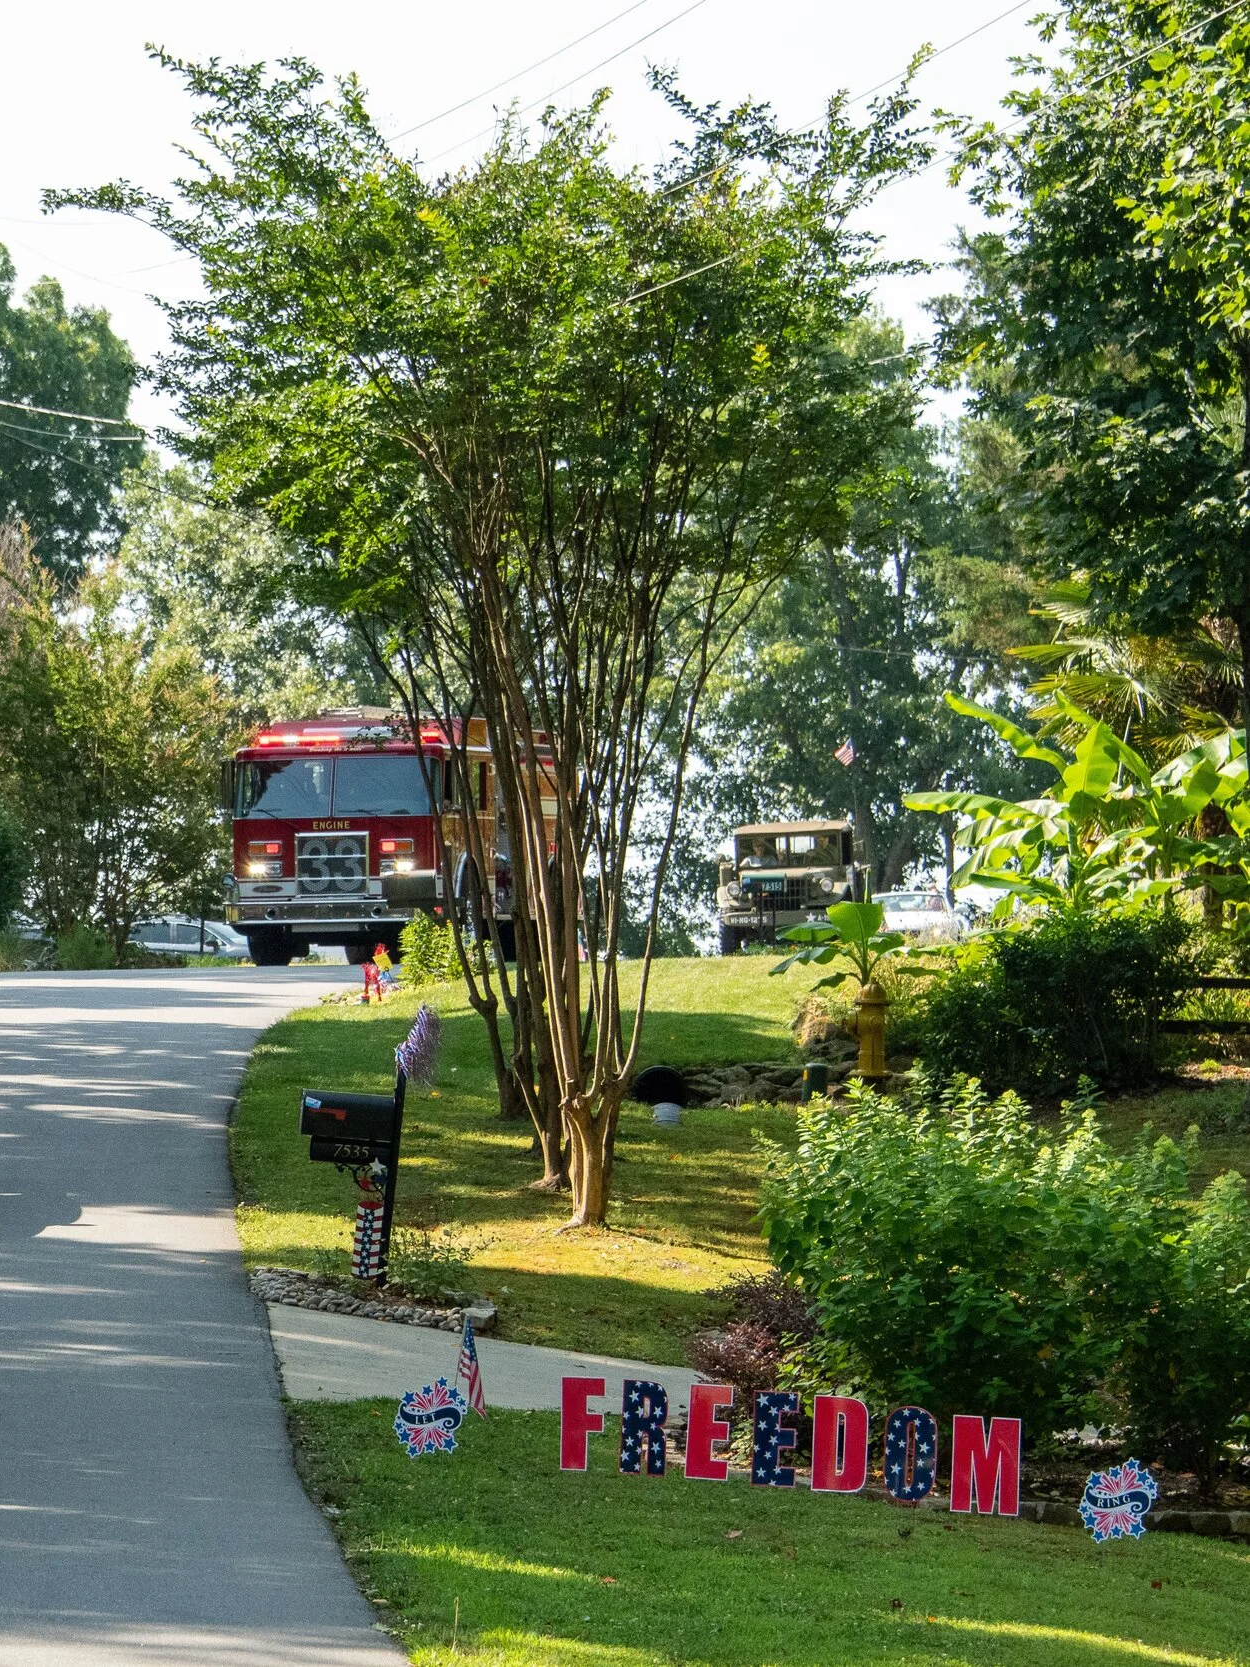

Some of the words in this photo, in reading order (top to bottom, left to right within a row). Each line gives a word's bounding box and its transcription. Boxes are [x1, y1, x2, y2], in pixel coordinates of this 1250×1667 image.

[312, 820, 351, 830] ENGINE
[301, 838, 363, 892] 33
[333, 1143, 370, 1159] 7535
[415, 1412, 436, 1425] LET
[559, 1376, 1022, 1517] FREEDOM
[1097, 1494, 1130, 1508] RING
